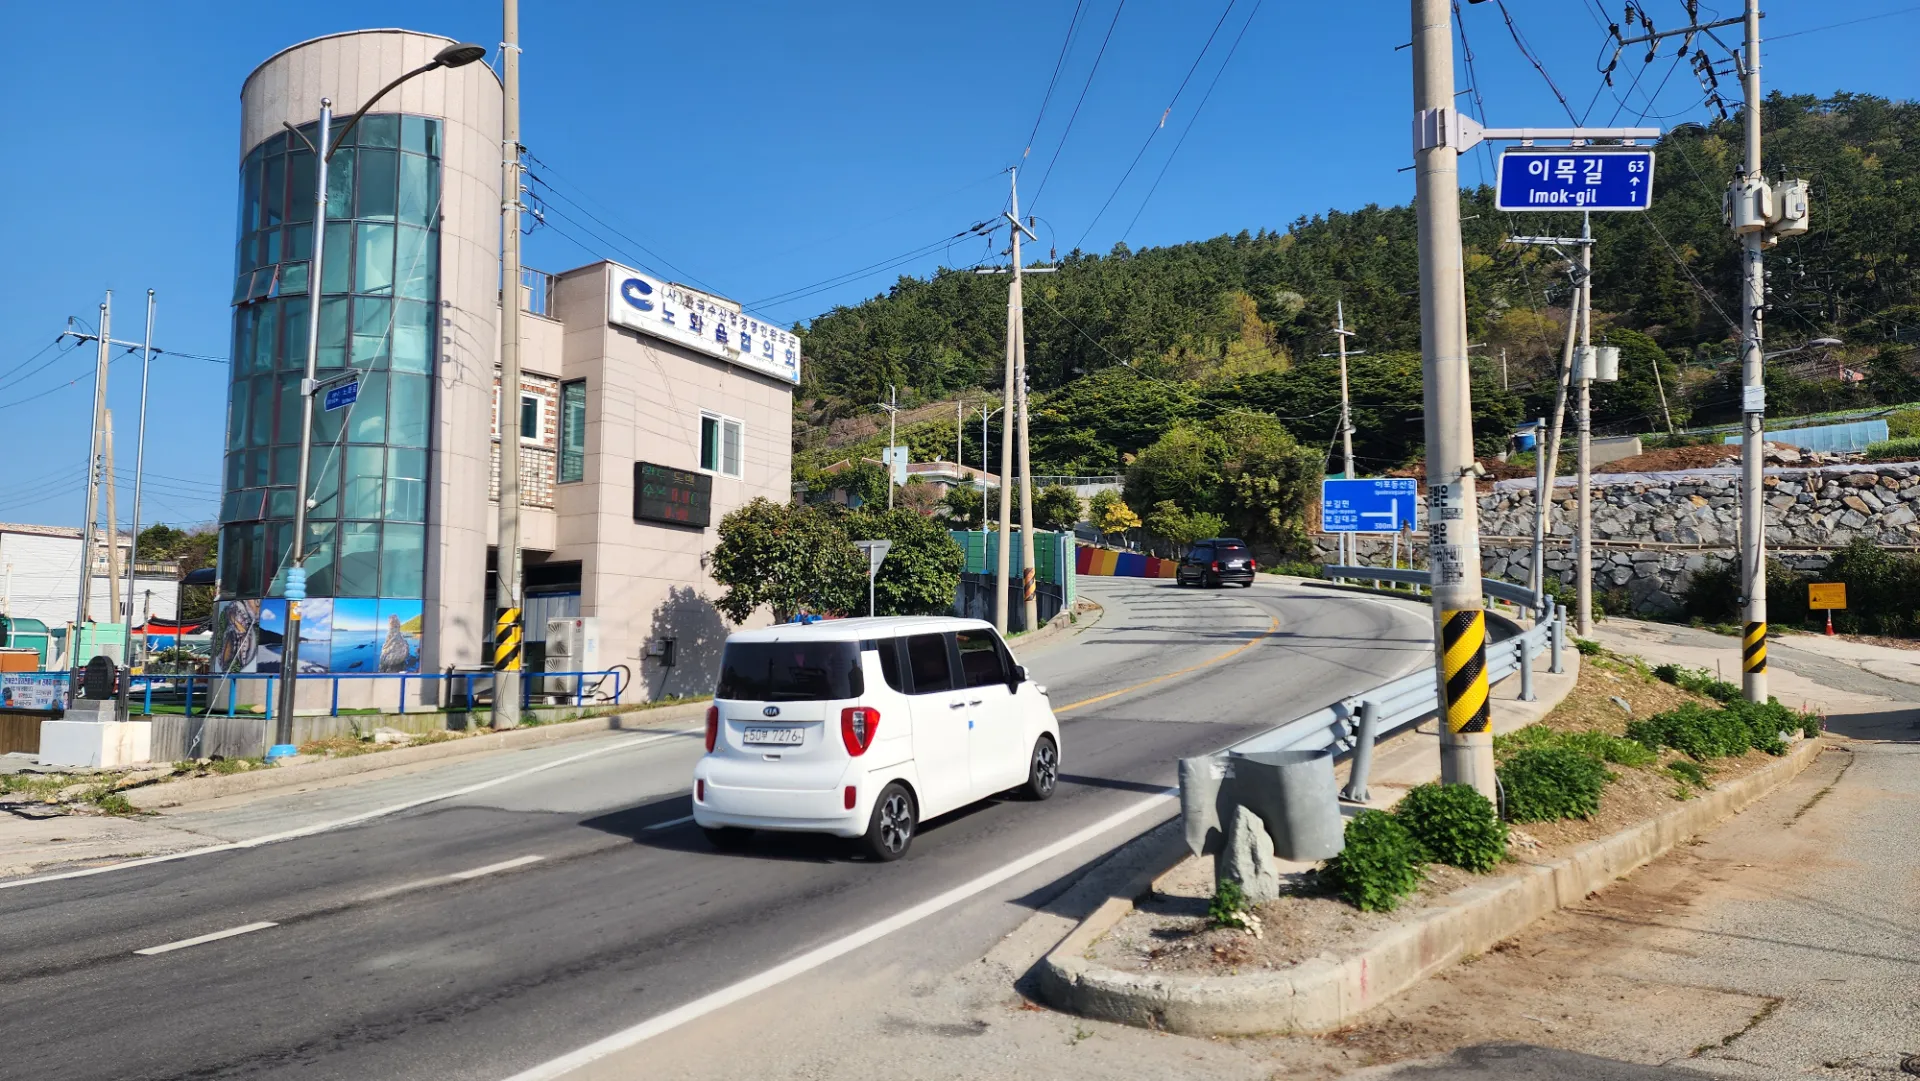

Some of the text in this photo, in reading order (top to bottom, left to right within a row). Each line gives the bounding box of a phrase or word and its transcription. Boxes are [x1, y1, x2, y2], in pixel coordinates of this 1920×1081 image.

[1528, 159, 1603, 185] 이목길
[1627, 161, 1645, 173] 63
[1529, 188, 1597, 206] Imok-gil
[1630, 190, 1636, 203] 1
[1325, 500, 1350, 508] 보길면
[1325, 515, 1358, 523] 보길대교
[773, 729, 798, 742] 7276
